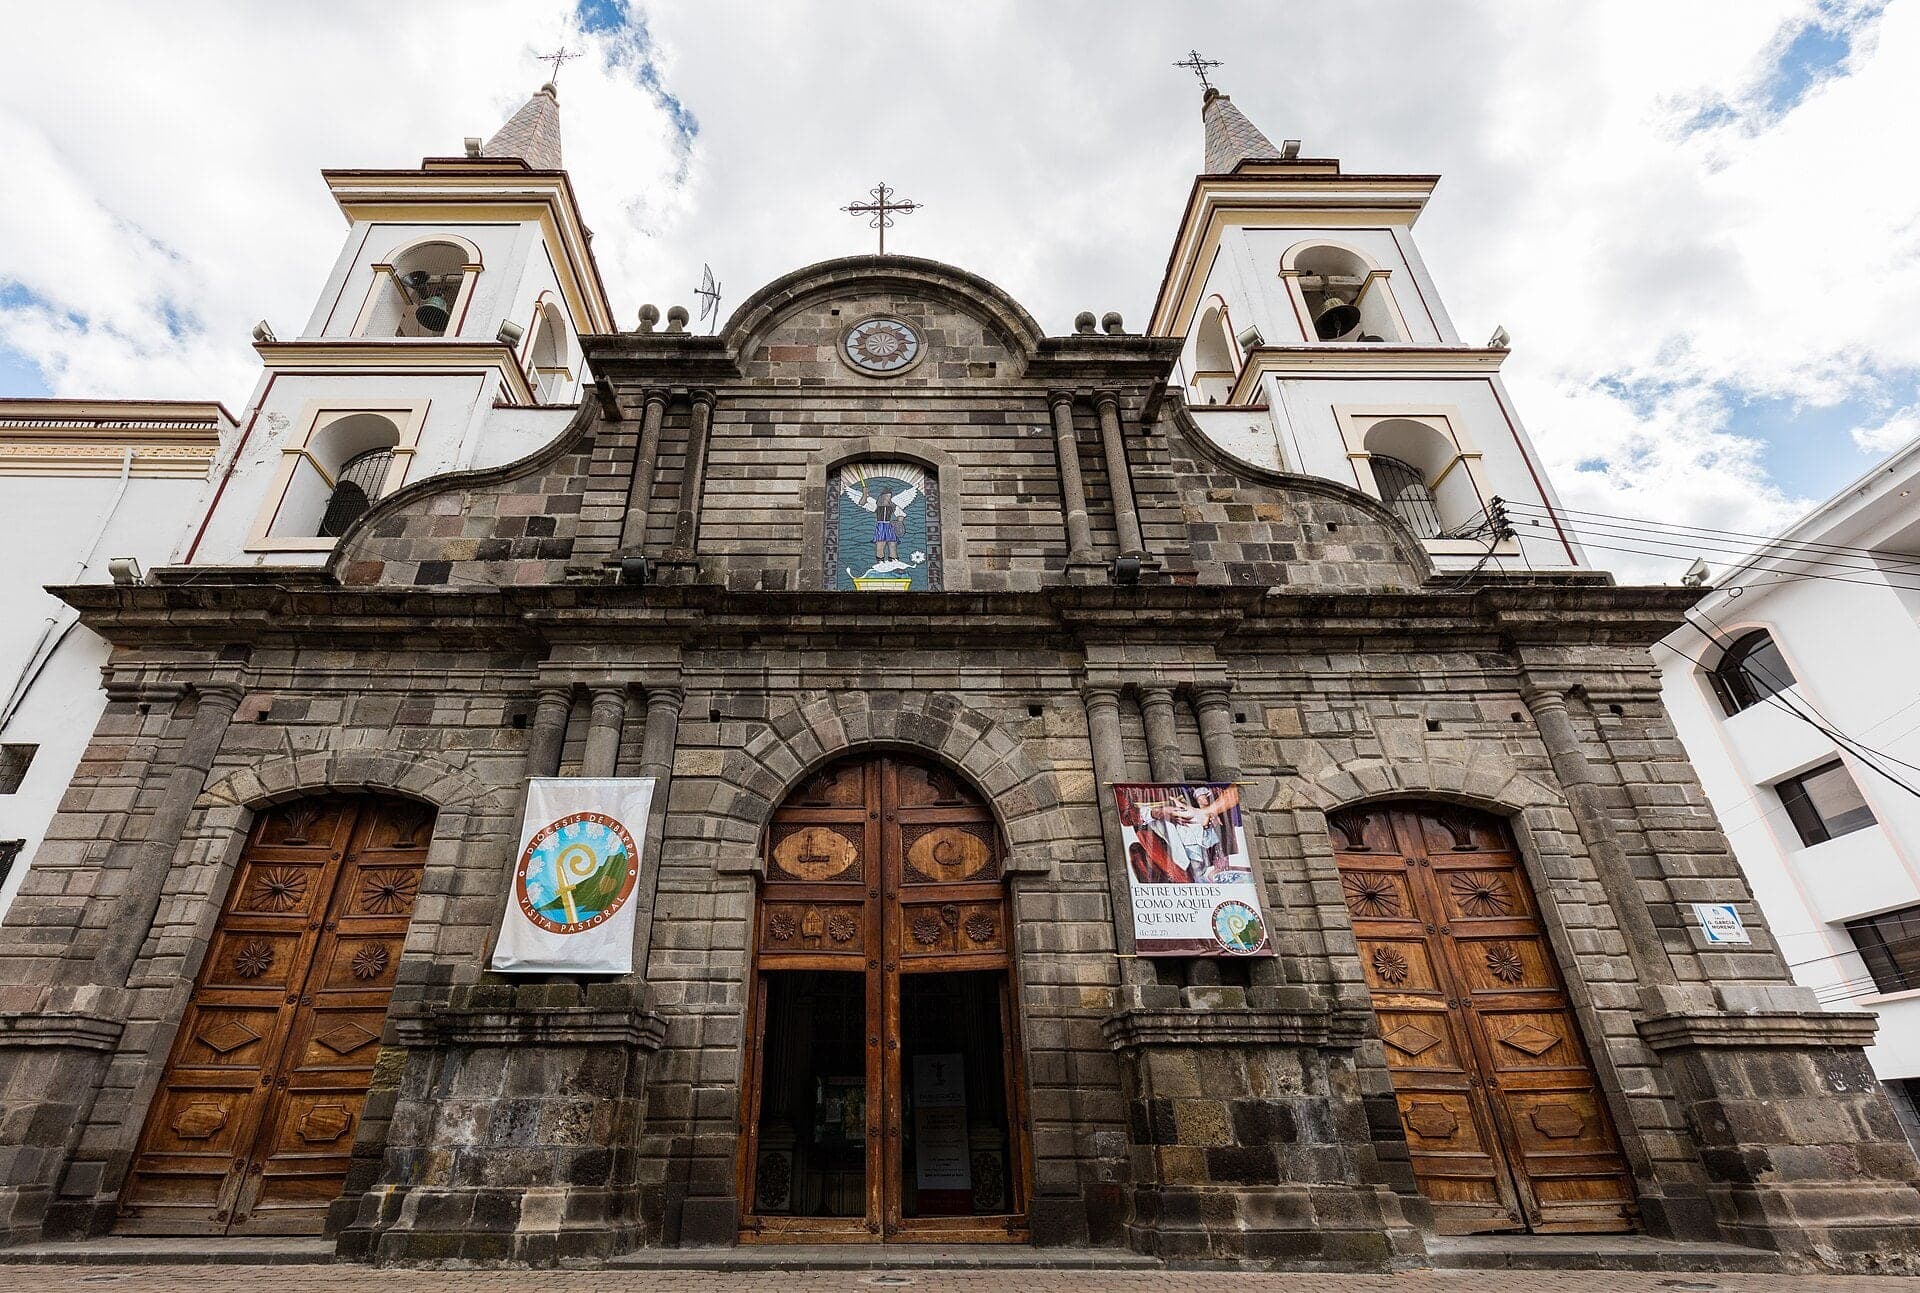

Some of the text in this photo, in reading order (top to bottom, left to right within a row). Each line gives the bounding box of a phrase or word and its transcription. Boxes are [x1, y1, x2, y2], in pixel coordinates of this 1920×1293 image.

[527, 814, 635, 859] DIOCESIS DE IBARRA
[1172, 887, 1221, 896] USTEDES
[1135, 898, 1173, 909] COMO
[1176, 898, 1214, 911] AQUEL
[520, 896, 624, 932] VISITA PASTORAL
[1137, 914, 1162, 925] QUE
